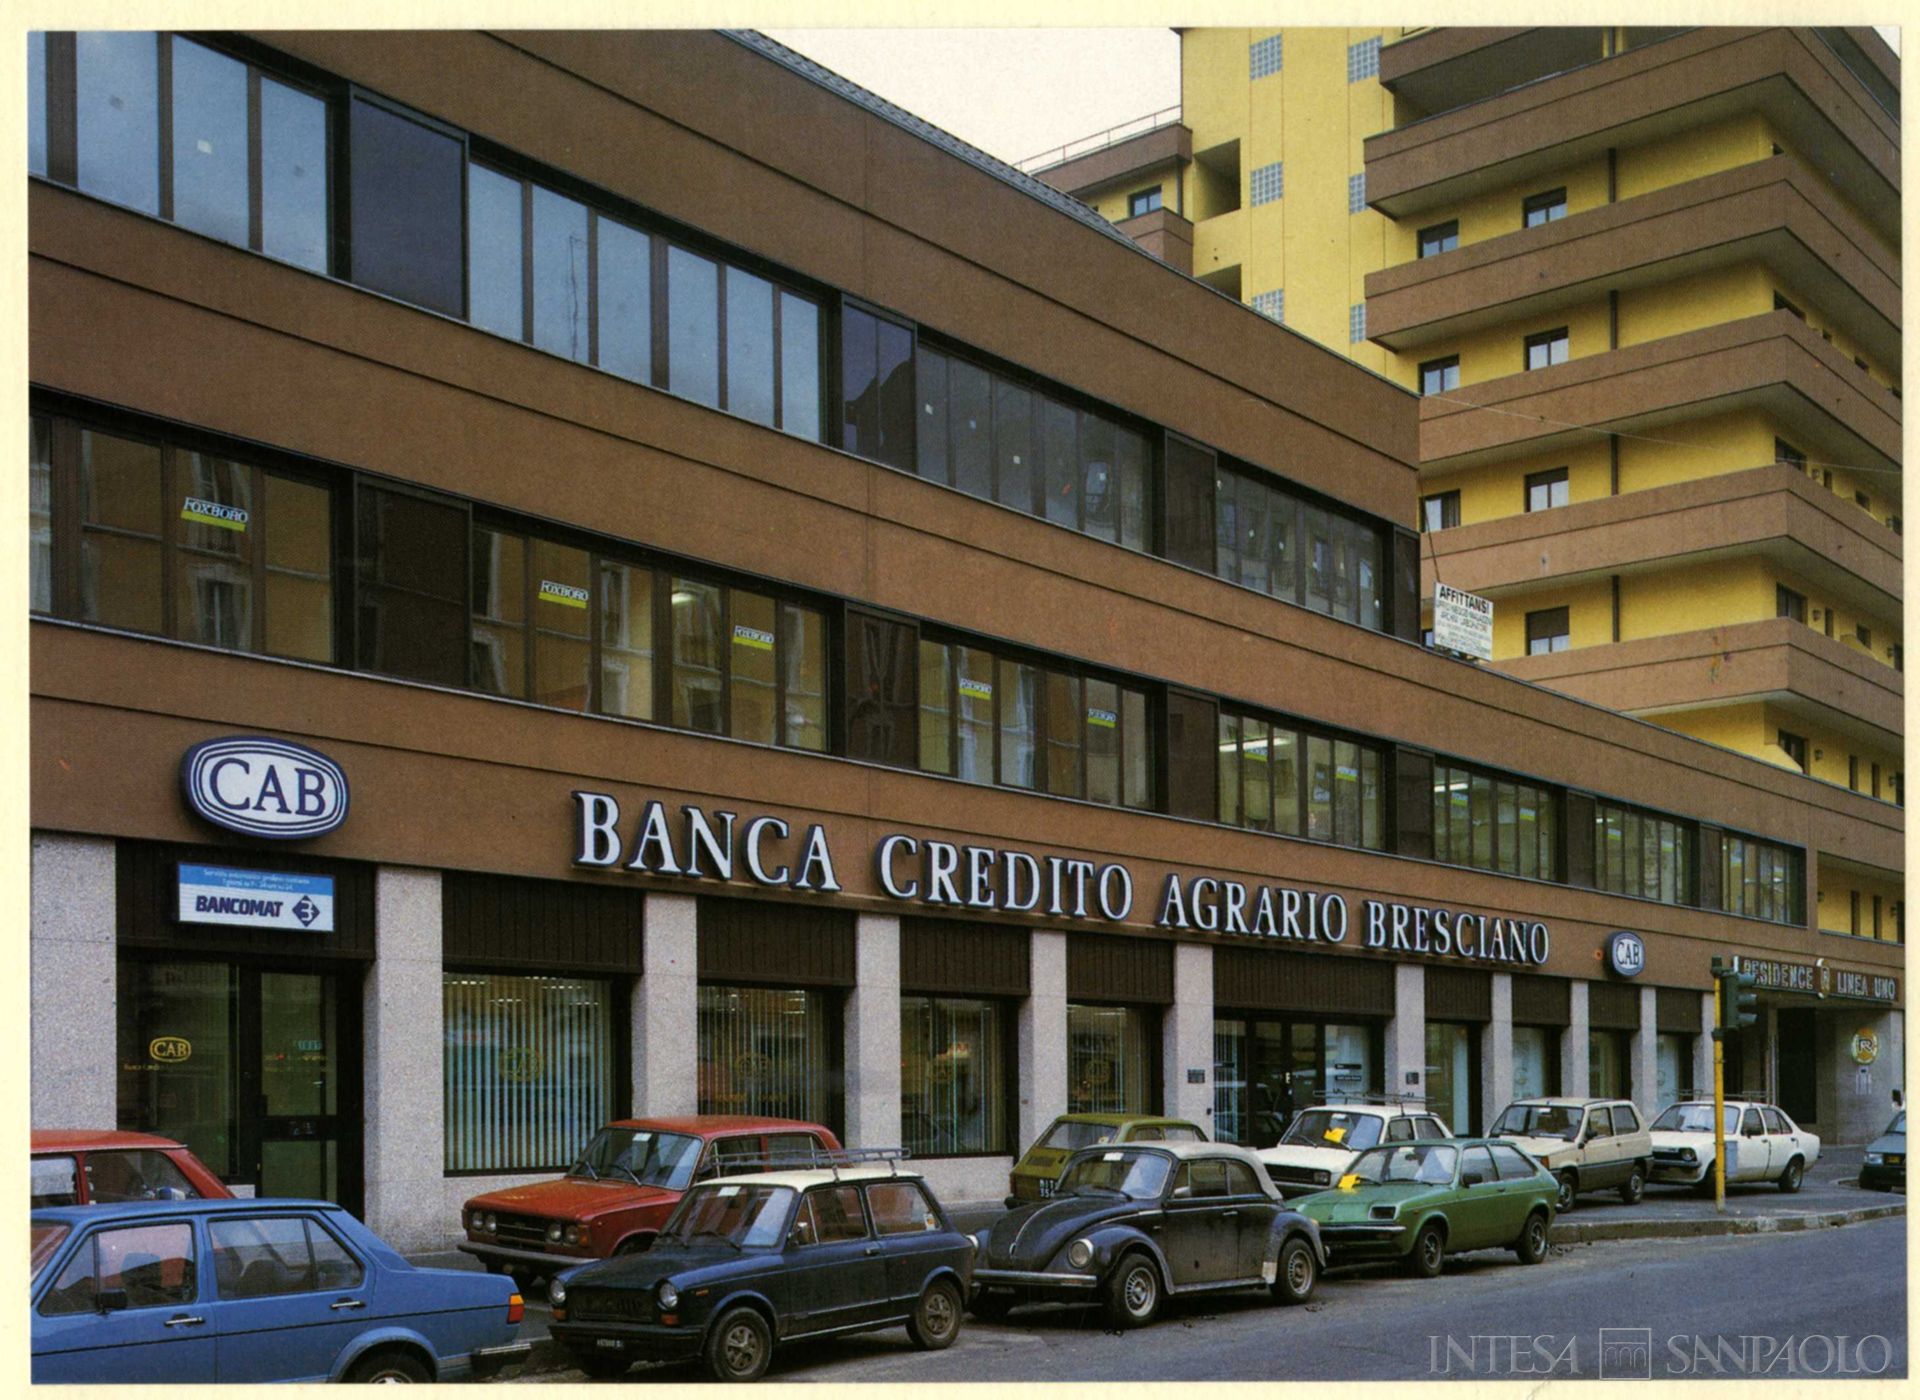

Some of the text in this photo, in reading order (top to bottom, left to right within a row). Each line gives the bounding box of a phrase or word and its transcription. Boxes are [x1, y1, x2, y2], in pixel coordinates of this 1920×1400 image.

[183, 497, 248, 523] FOXBORO
[541, 580, 589, 601] FOXBORO
[1439, 585, 1490, 614] AFFITTANSI
[210, 757, 325, 817] CAB
[571, 791, 1550, 965] BANCA CREDITO AGRARIO BRESCIANO
[196, 895, 283, 917] BANCOMAT
[1616, 941, 1640, 965] CAB
[1837, 971, 1868, 997] LINEA
[1874, 977, 1895, 1000] UNO
[154, 1042, 187, 1057] CAB
